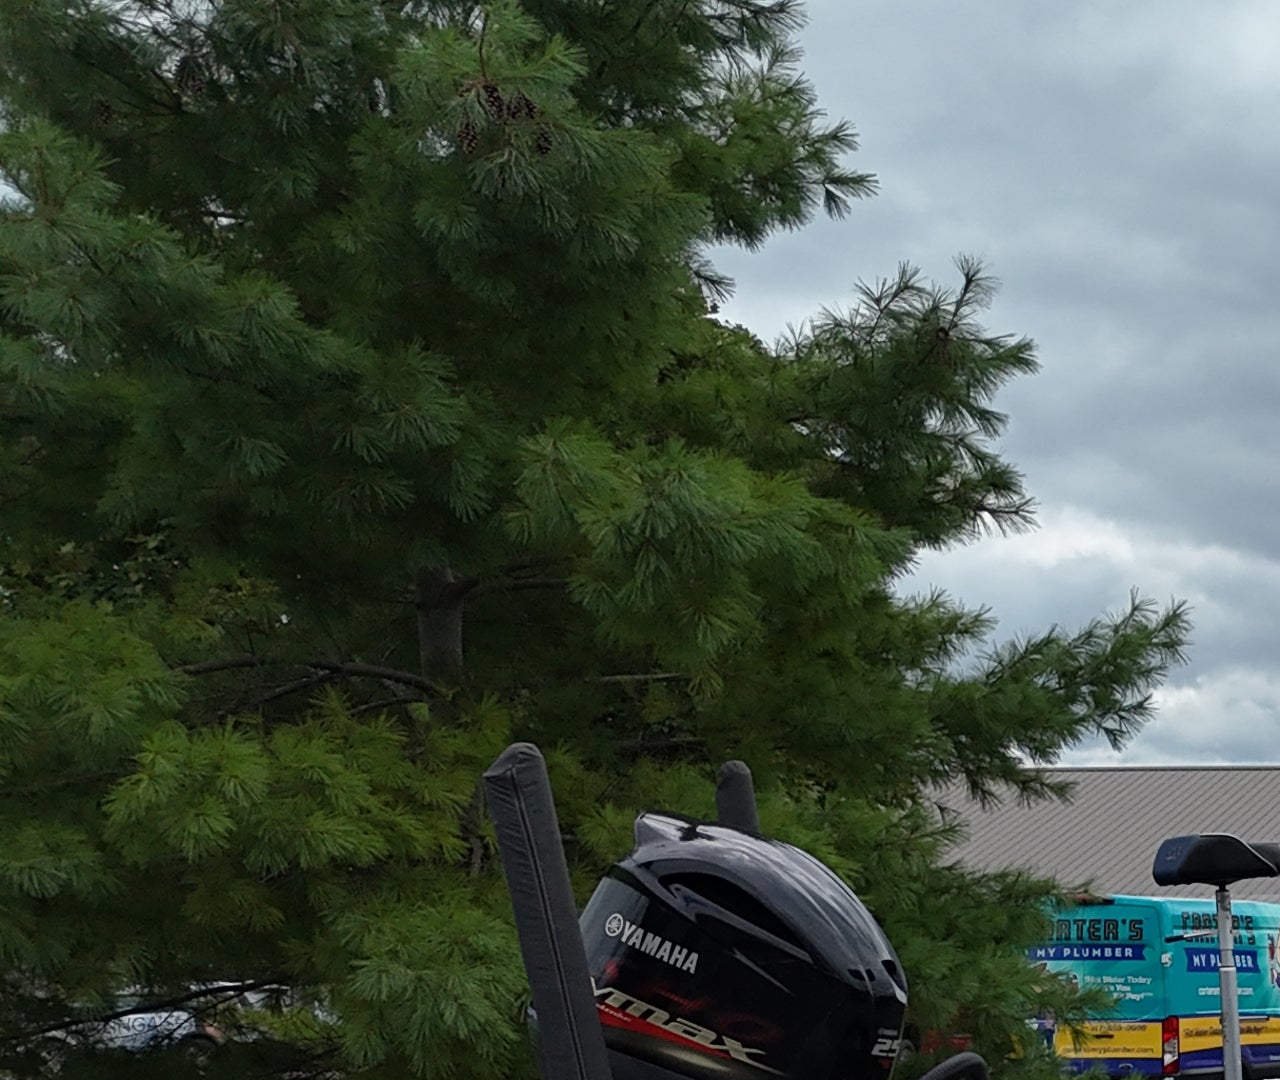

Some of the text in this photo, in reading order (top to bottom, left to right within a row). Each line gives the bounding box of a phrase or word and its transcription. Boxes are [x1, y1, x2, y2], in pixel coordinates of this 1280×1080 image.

[621, 920, 700, 974] YAMAHA
[1036, 947, 1134, 958] MY PLUMBER
[1192, 953, 1254, 969] MY PLBER
